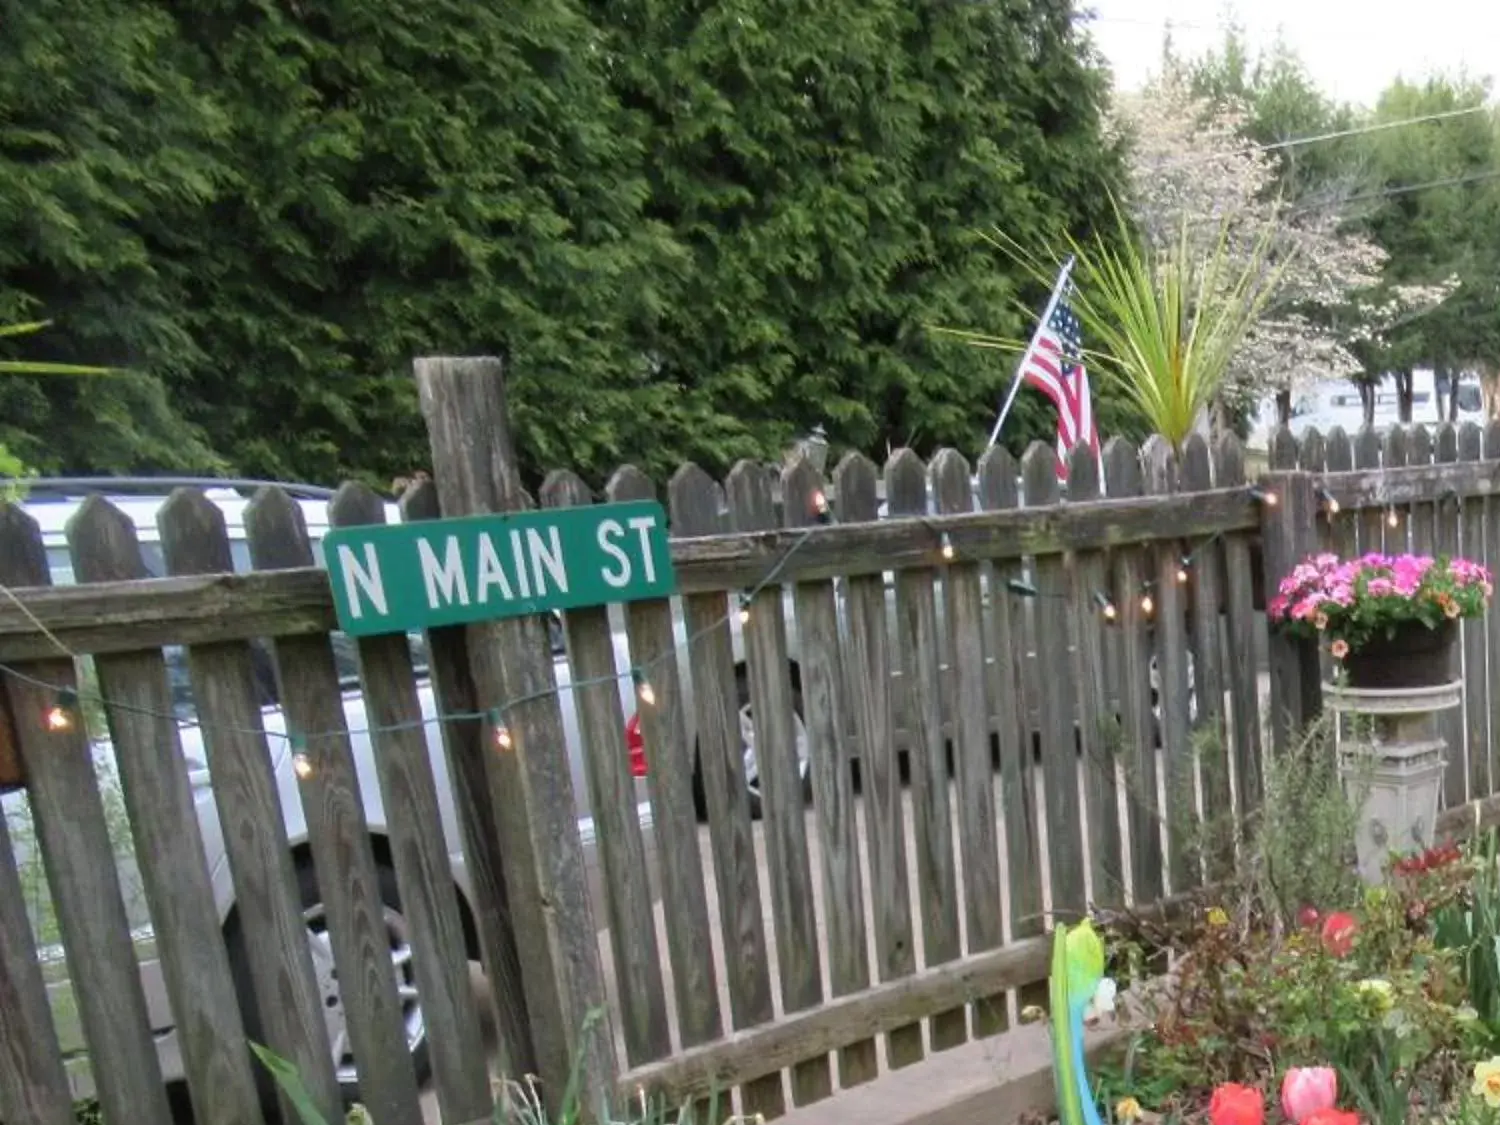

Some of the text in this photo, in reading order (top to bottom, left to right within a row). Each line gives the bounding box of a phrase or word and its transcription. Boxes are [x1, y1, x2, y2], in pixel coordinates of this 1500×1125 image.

[338, 516, 656, 619] N MAIN ST
